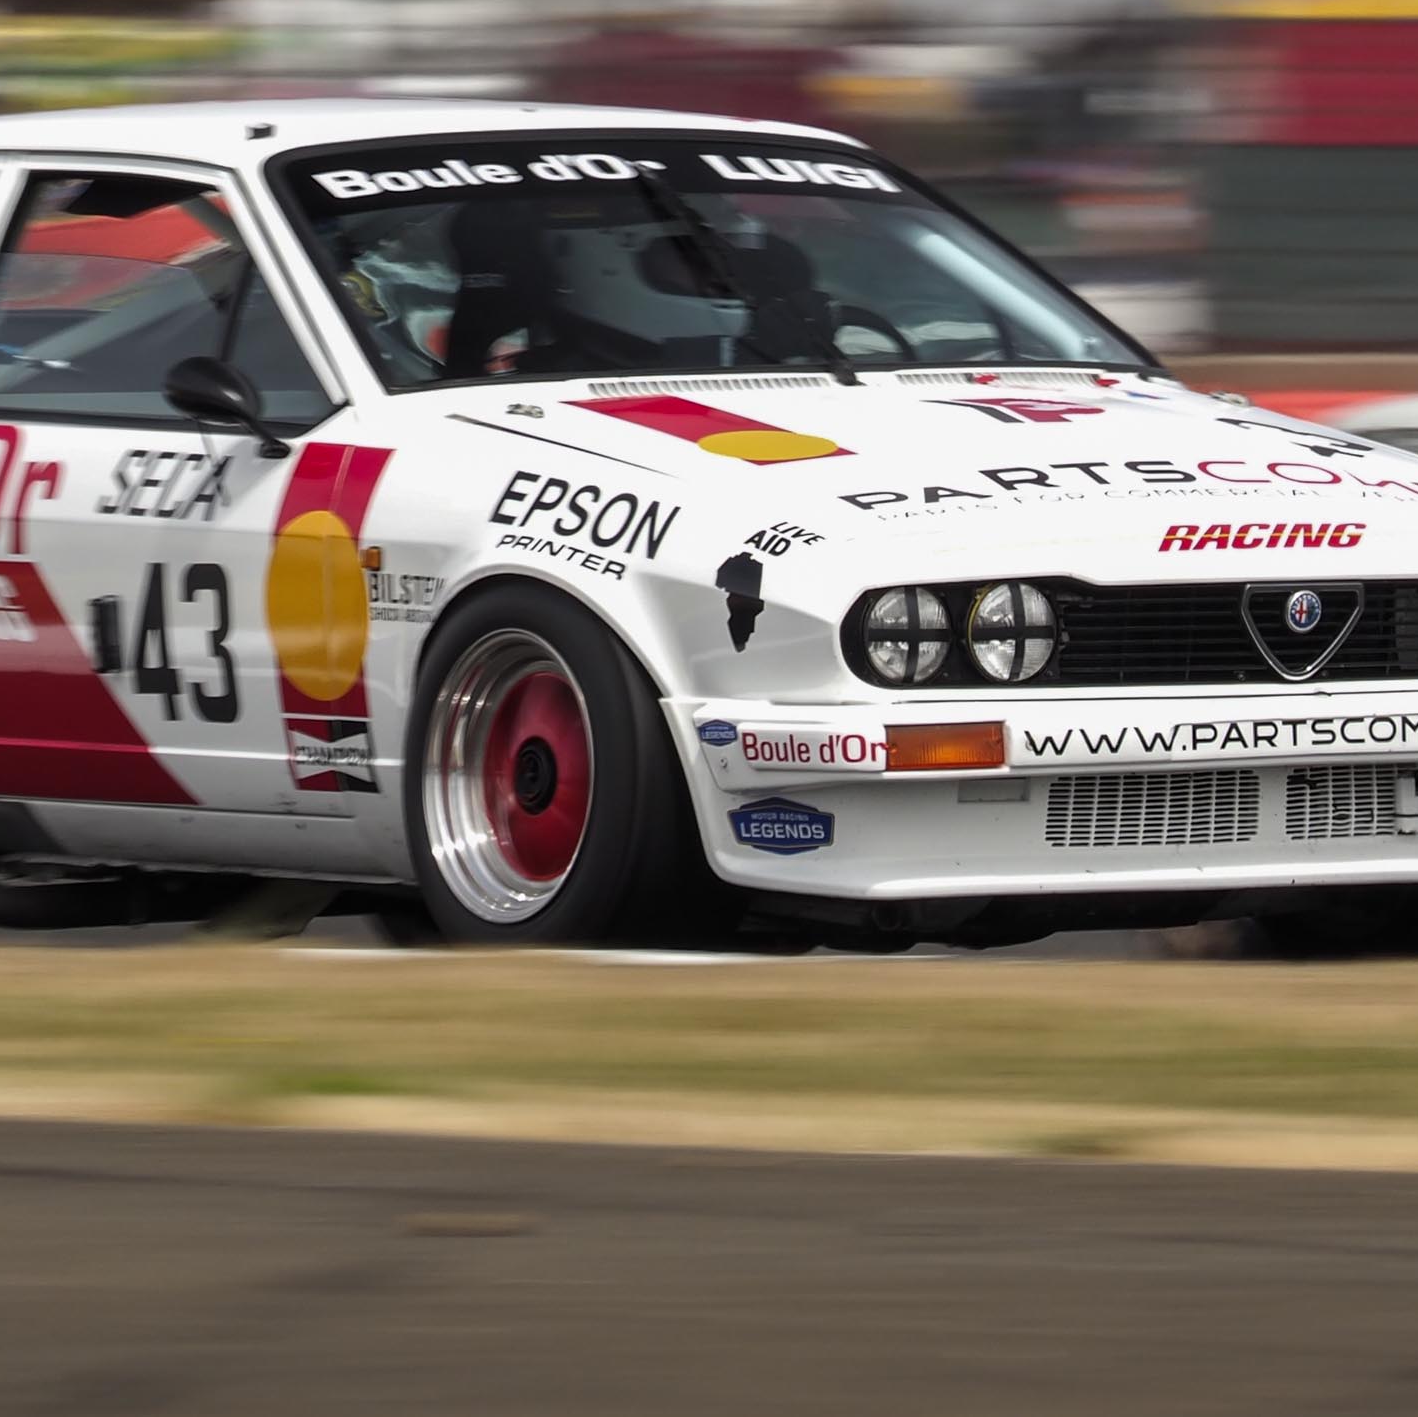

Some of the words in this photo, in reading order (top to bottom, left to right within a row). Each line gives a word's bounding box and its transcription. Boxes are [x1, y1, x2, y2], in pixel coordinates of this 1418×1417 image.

[312, 158, 524, 199] Boule
[699, 154, 902, 193] LUIGI
[488, 470, 681, 560] EPSON
[744, 529, 792, 557] AID
[770, 521, 827, 546] LIVE
[1158, 523, 1367, 552] RACING
[495, 534, 627, 581] PRINTER
[129, 562, 242, 723] 43
[741, 732, 811, 763] Boule
[819, 733, 890, 764] d'Or
[740, 822, 825, 839] LEGENDS
